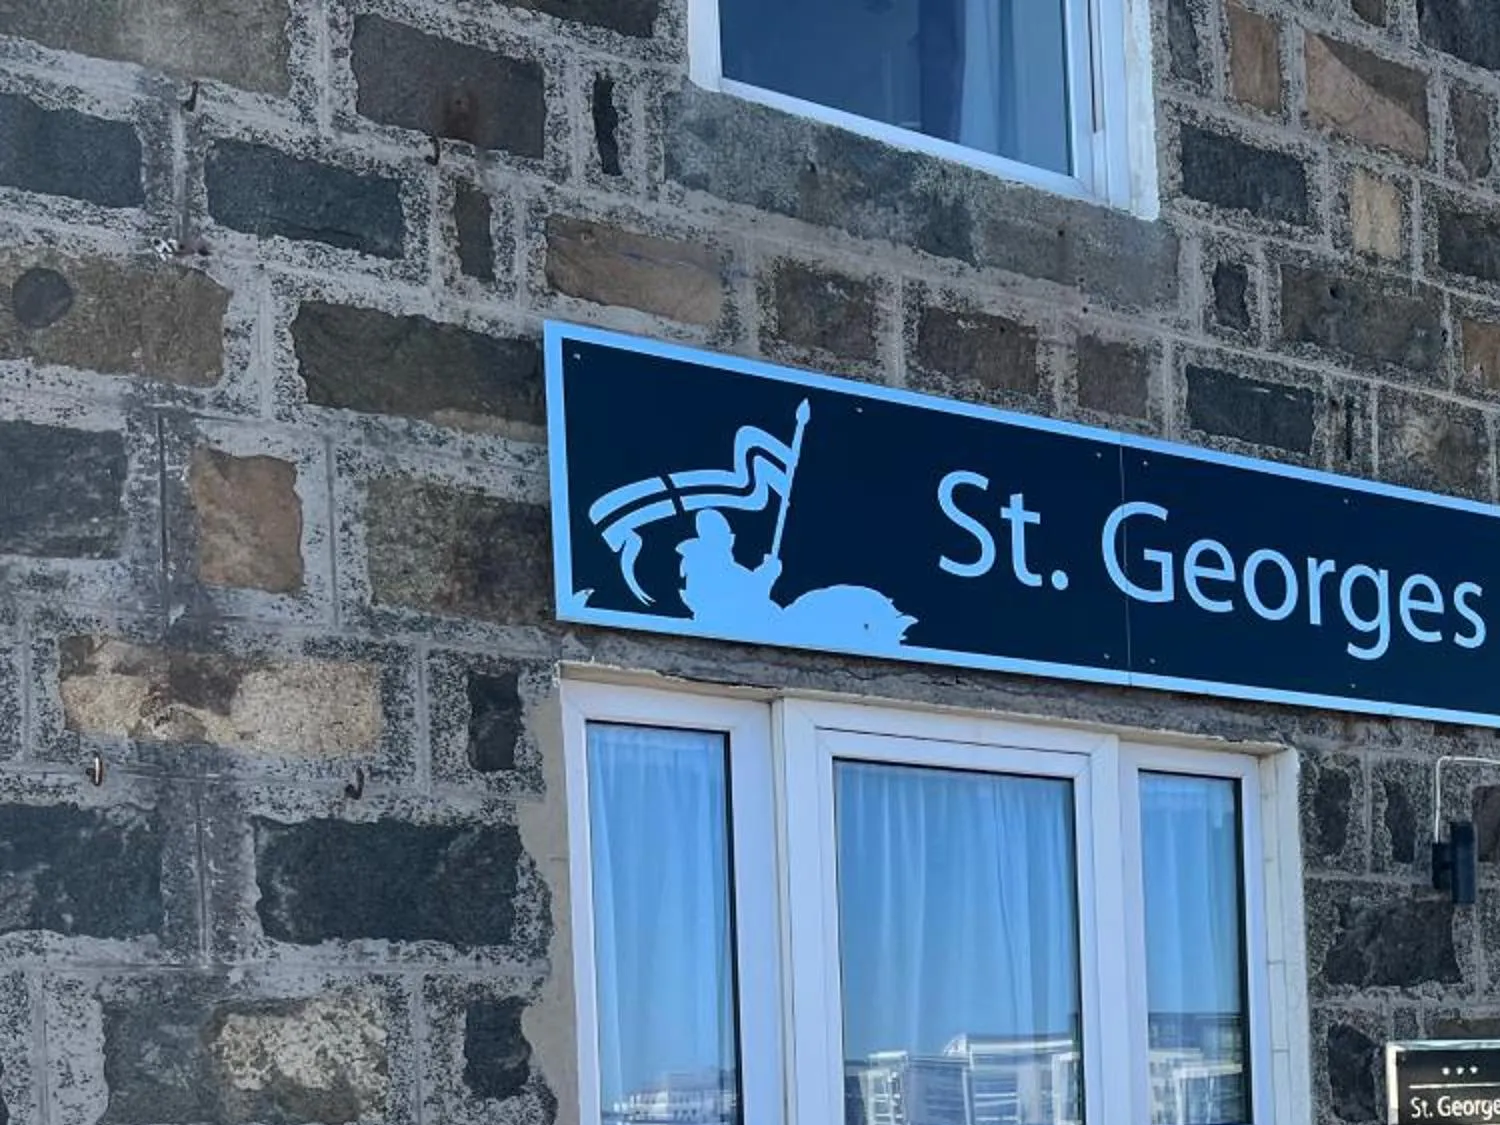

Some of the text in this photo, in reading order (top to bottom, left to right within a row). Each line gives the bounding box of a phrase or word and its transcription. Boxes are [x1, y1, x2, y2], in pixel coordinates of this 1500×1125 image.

[938, 470, 1069, 591] St.
[1101, 501, 1486, 661] Georges
[1410, 1096, 1434, 1119] St.
